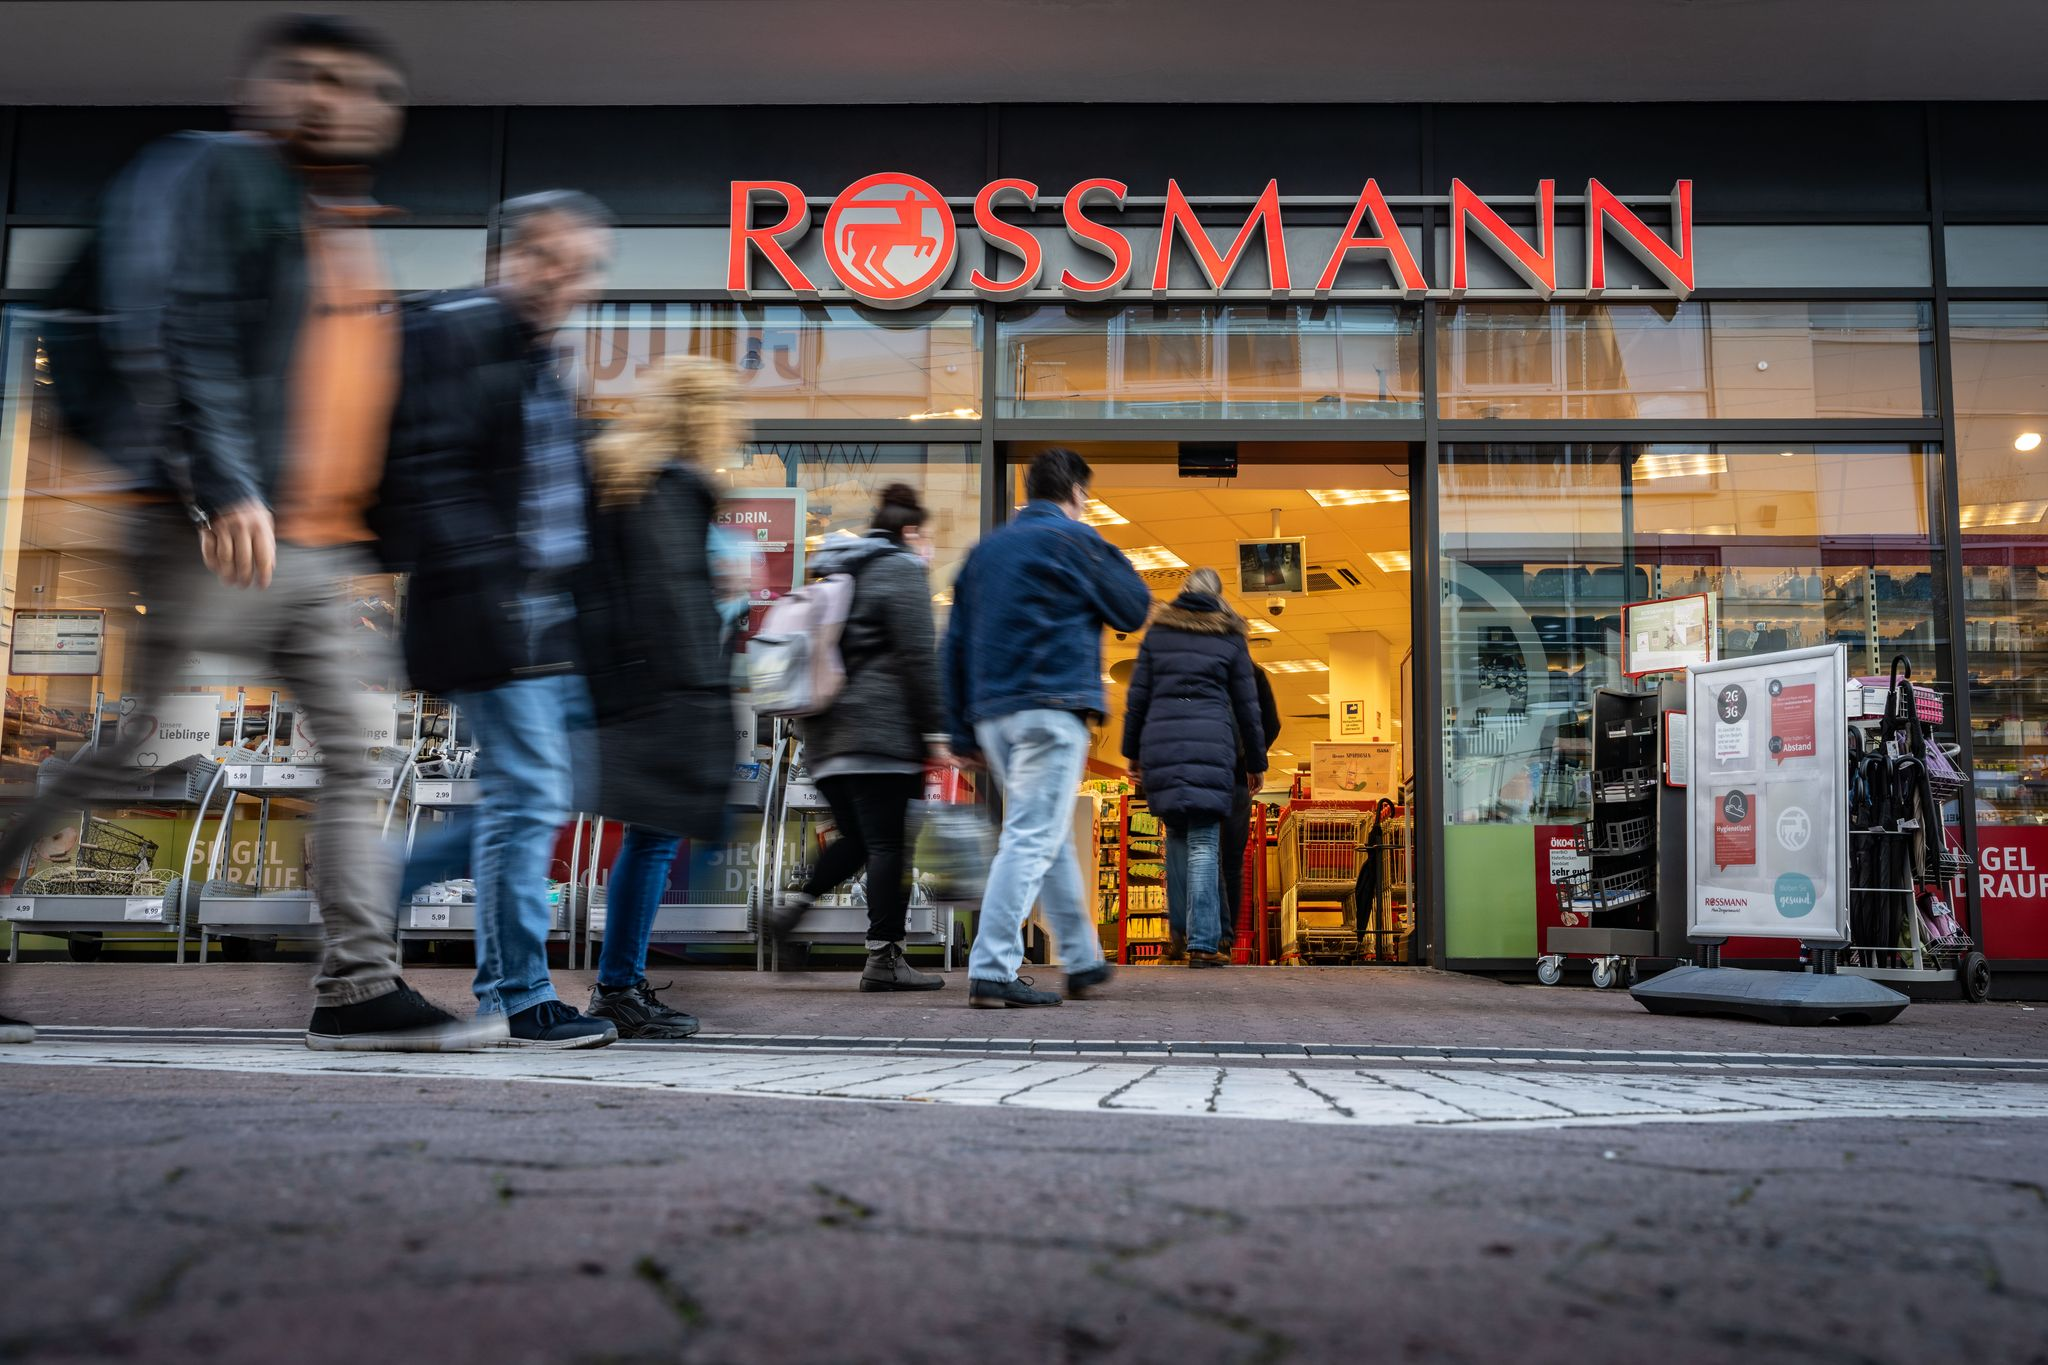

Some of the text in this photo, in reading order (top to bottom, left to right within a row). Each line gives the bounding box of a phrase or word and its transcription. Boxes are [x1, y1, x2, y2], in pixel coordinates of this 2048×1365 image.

[725, 170, 1697, 308] ROSSMANN
[735, 511, 772, 524] DRIN.
[1725, 690, 1738, 703] 2G
[1725, 706, 1738, 719] 3G
[159, 729, 211, 741] Lieblinge
[1782, 741, 1812, 752] Abstand
[233, 772, 248, 780] 5,99
[280, 772, 295, 780] 4,99
[435, 791, 450, 799] 2,99
[1551, 867, 1586, 877] sehr gut
[1704, 897, 1748, 907] ROSSMANN
[431, 913, 446, 921] 5,99
